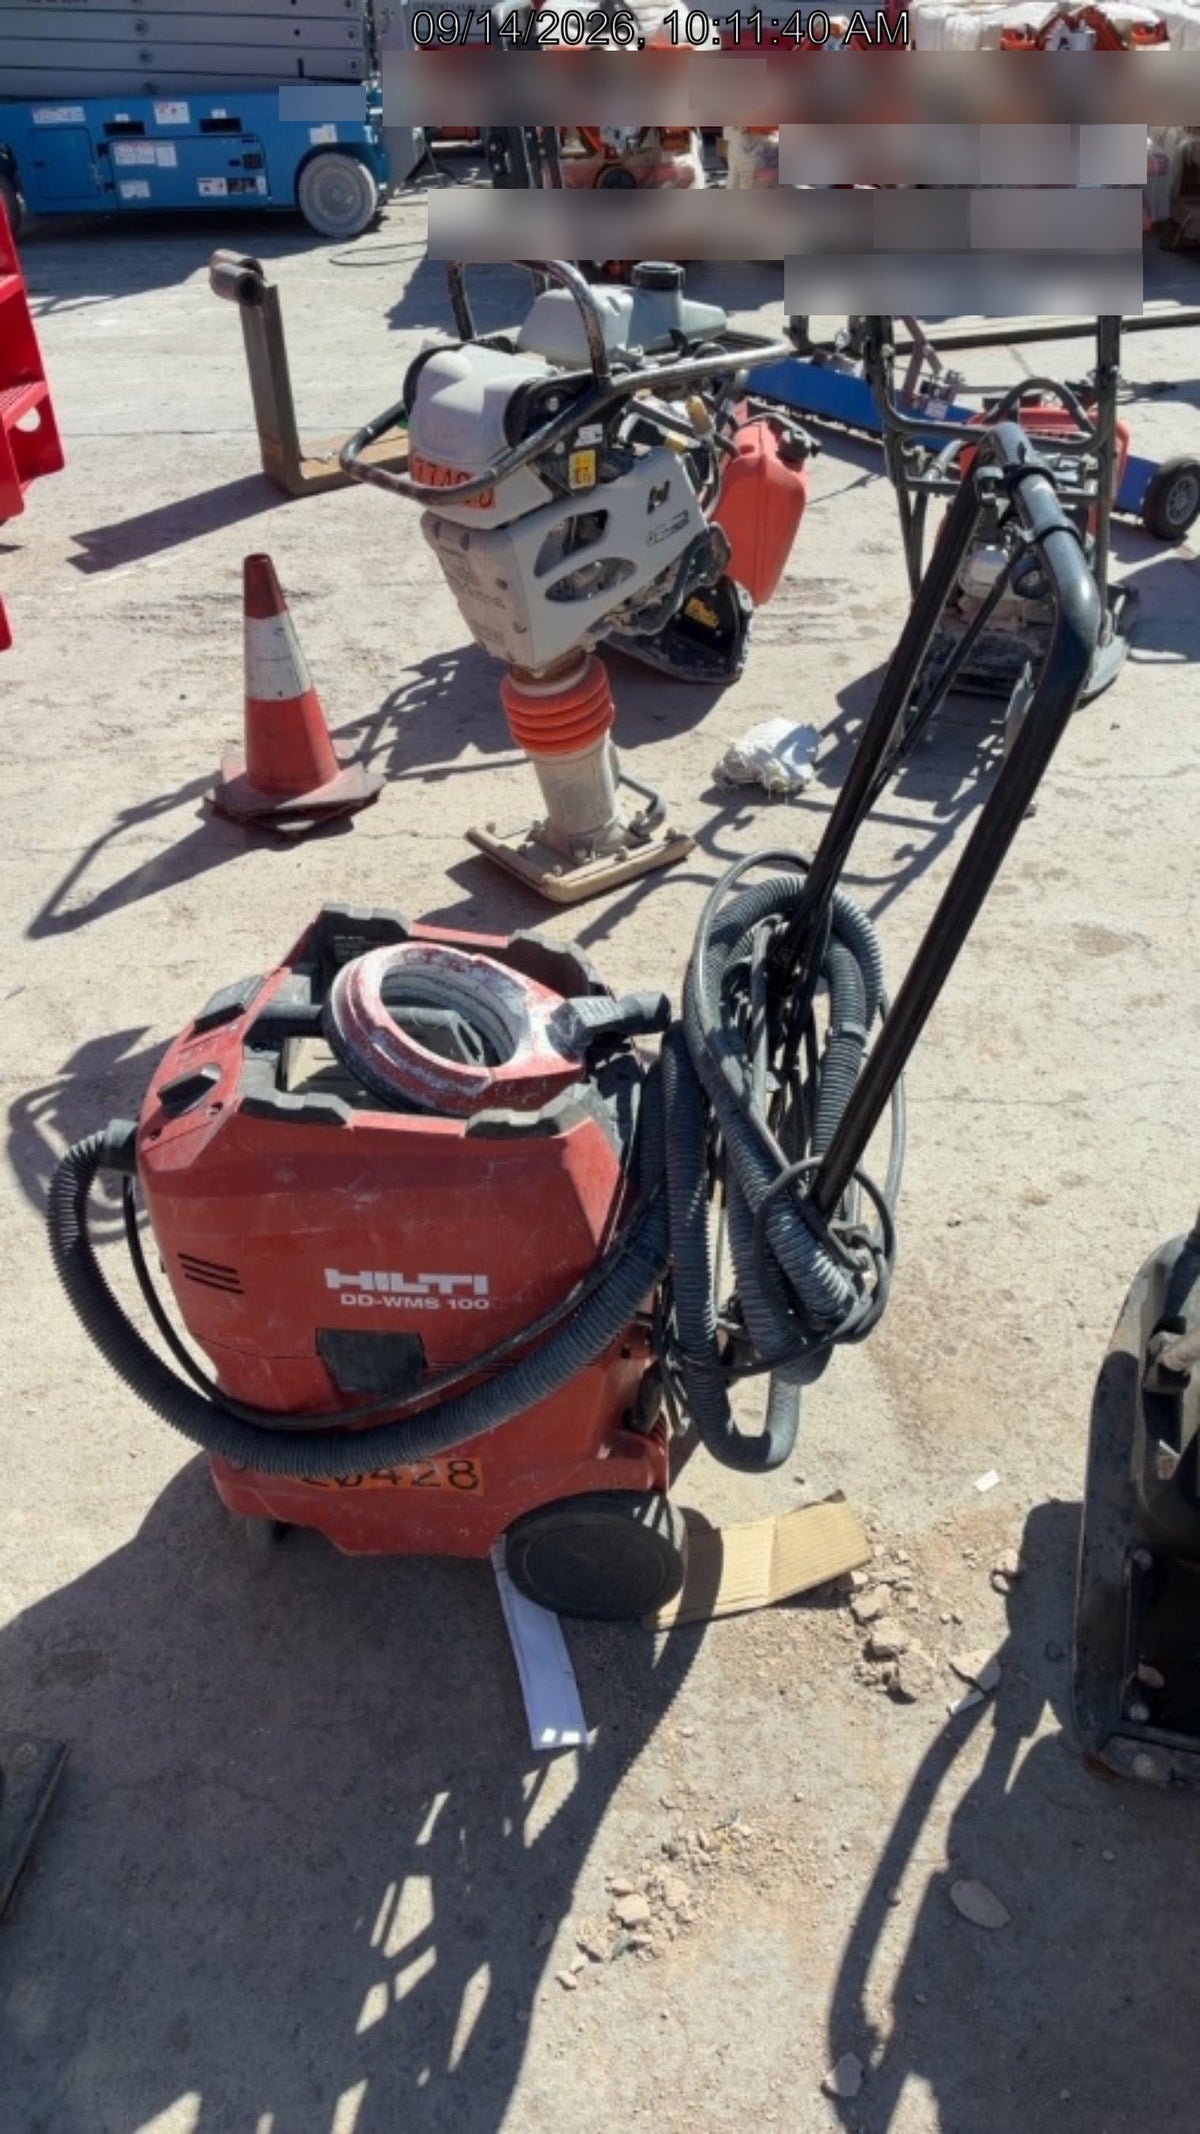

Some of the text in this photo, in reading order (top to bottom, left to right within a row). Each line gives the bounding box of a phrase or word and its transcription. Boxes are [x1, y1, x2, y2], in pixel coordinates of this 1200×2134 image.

[324, 1268, 489, 1296] HILTI
[340, 1293, 490, 1311] DD-WMS 100
